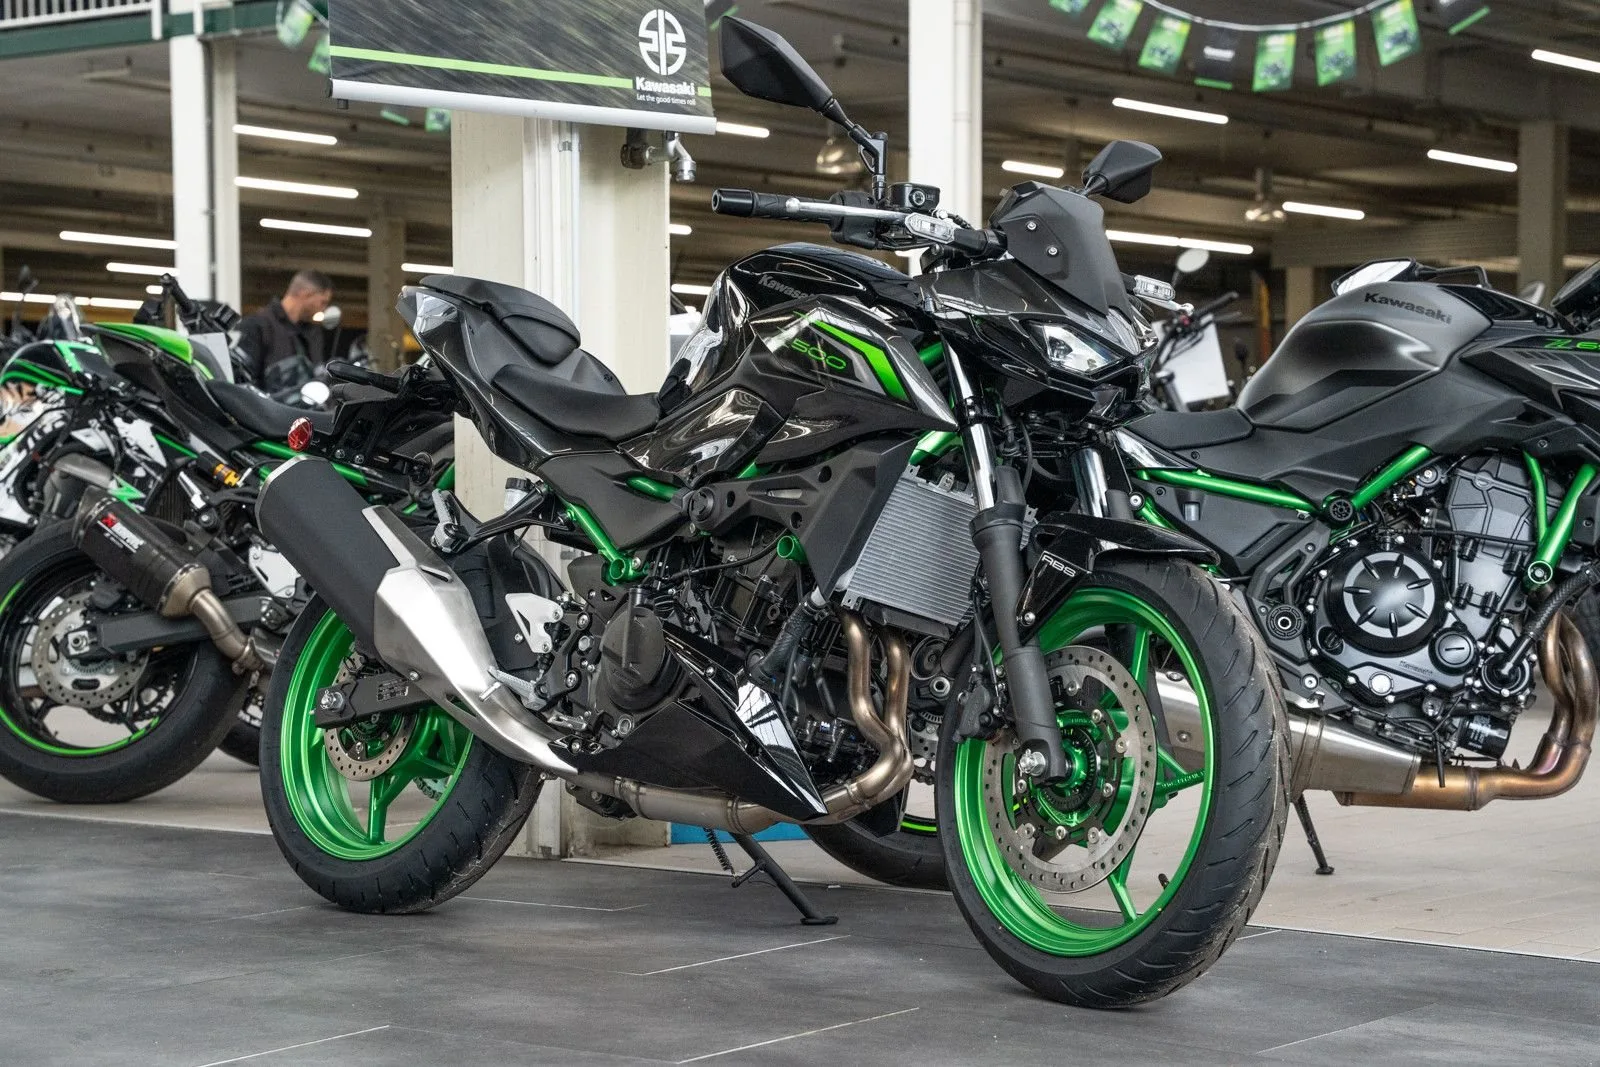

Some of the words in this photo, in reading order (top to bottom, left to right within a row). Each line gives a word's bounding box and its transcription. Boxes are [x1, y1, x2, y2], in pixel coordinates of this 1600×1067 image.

[636, 76, 695, 95] Kawasaki
[656, 96, 671, 105] good
[758, 274, 816, 300] Kawasa
[1364, 292, 1452, 325] Kawasaki
[1041, 554, 1077, 578] ABS
